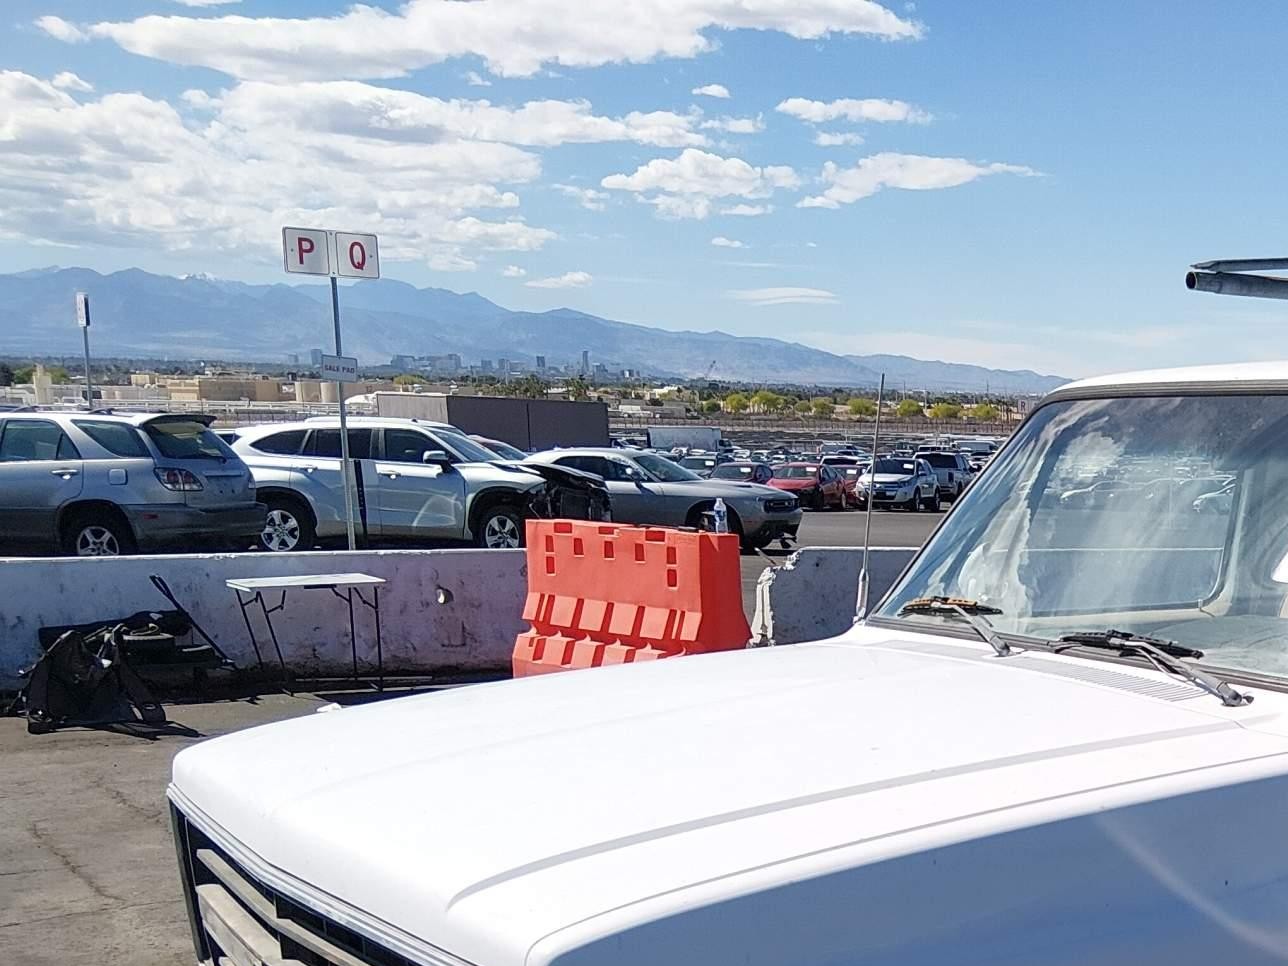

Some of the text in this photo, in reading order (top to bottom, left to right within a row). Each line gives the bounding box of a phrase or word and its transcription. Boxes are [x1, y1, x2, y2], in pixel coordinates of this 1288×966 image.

[297, 236, 315, 265] P
[348, 241, 366, 270] Q
[1020, 400, 1026, 411] R
